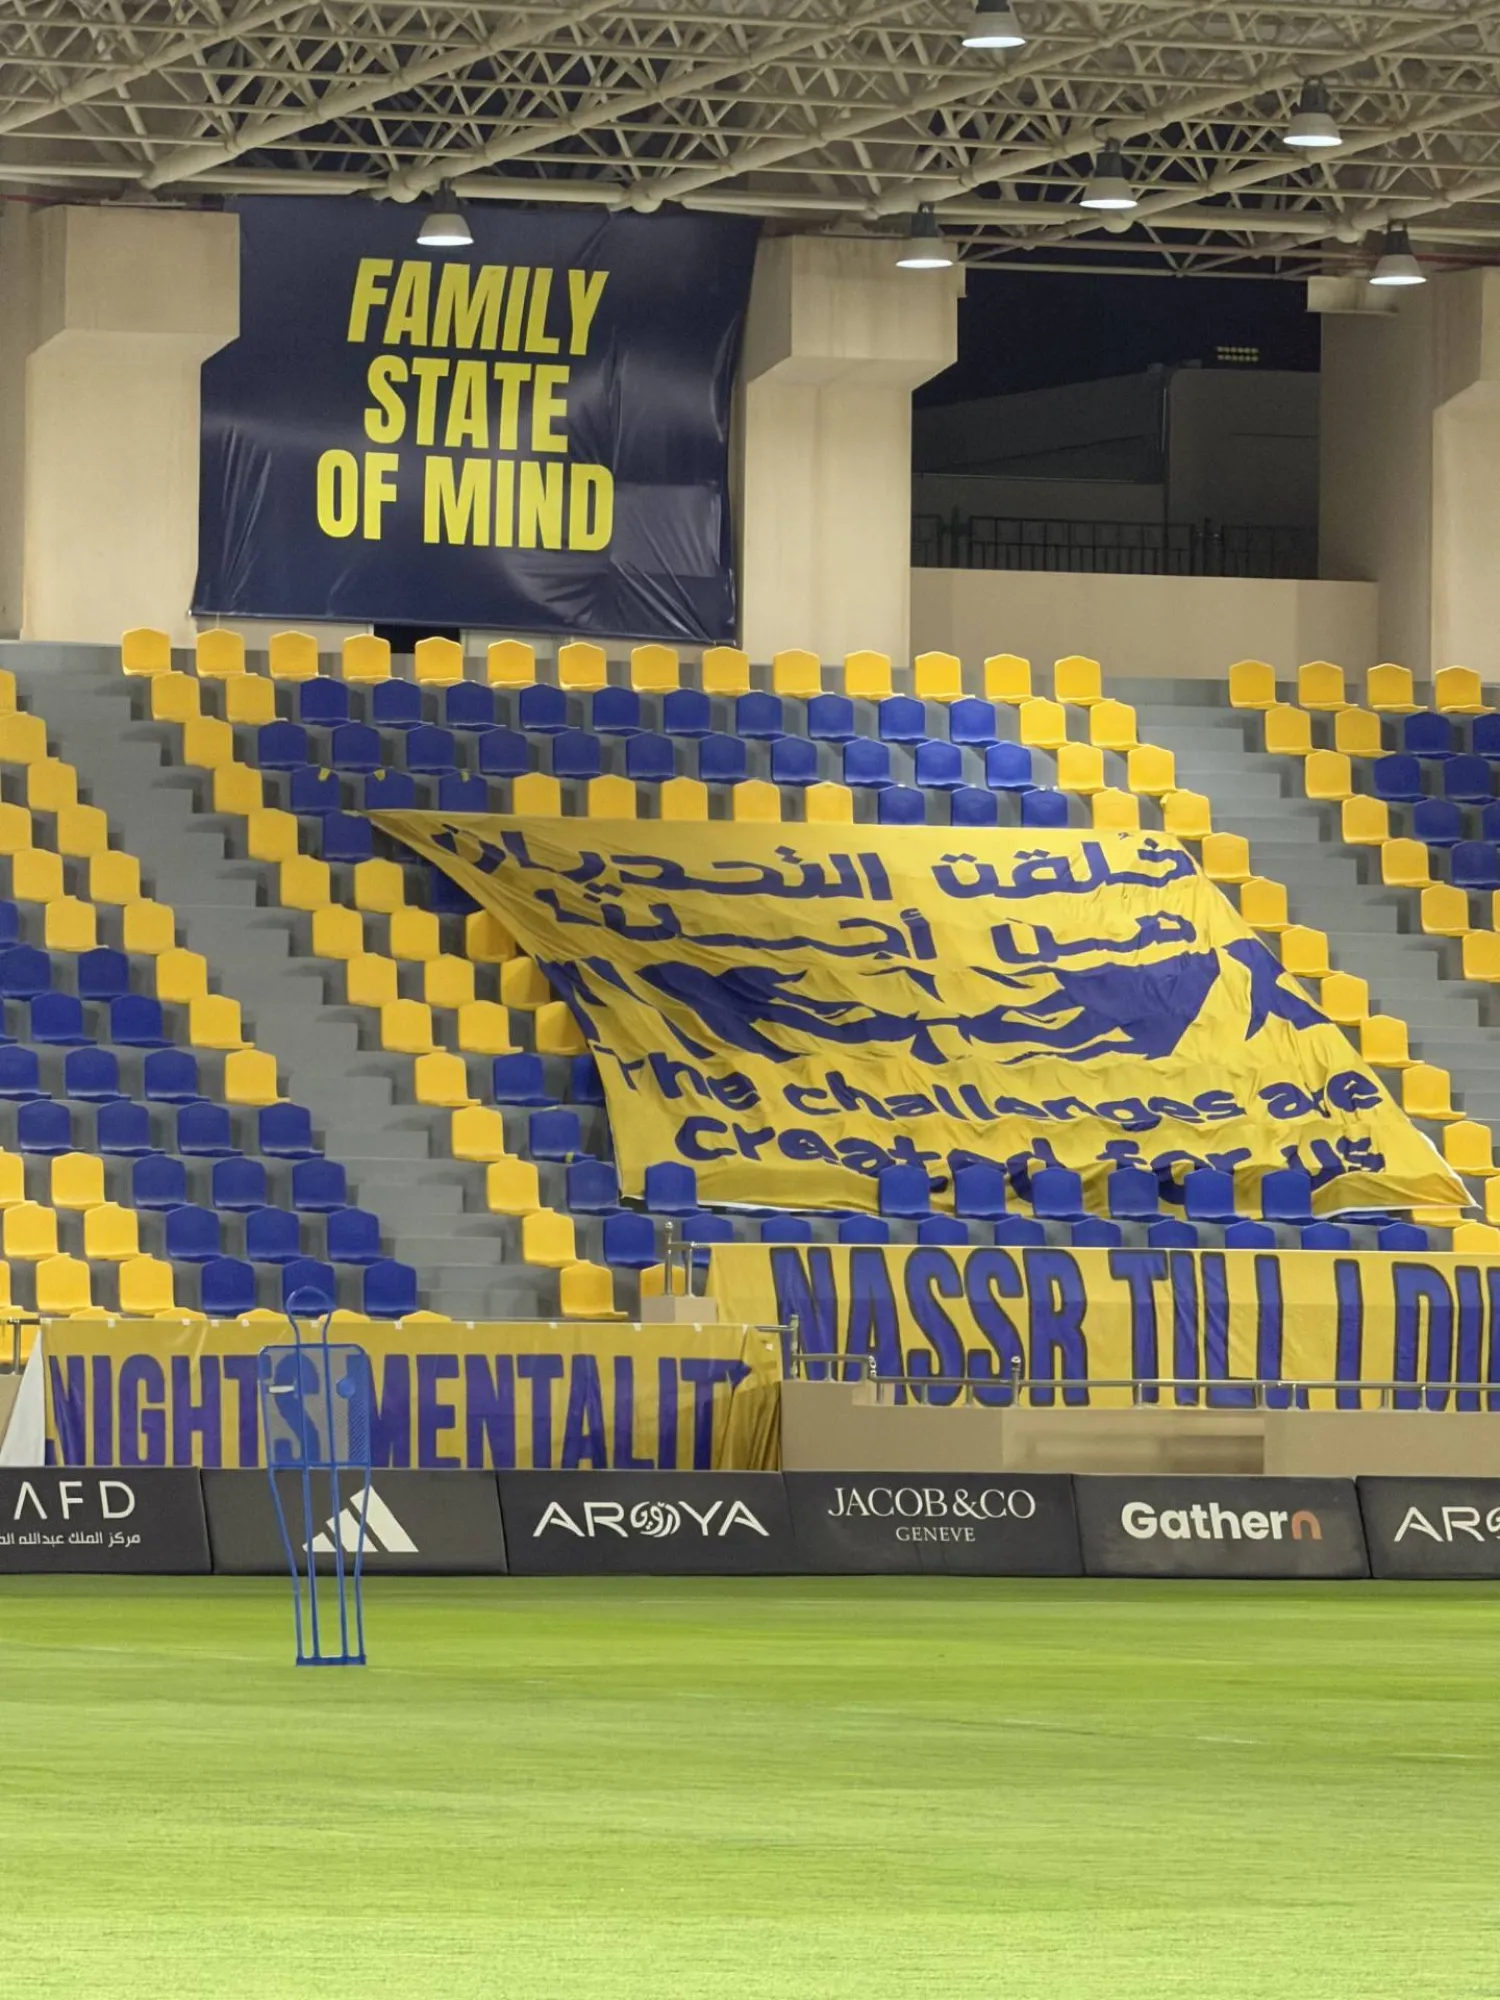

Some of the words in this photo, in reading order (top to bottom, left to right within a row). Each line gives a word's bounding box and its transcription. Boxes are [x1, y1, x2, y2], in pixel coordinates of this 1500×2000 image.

[347, 257, 609, 355] FAMILY
[364, 355, 570, 453] STATE
[316, 449, 397, 541] OF
[424, 456, 614, 552] MIND
[932, 837, 1198, 899] خلقت
[990, 909, 1198, 964] من
[1258, 1070, 1383, 1119] are
[770, 1246, 1090, 1408] NASSR
[1109, 1249, 1309, 1410] TILL
[1334, 1258, 1364, 1410] I
[68, 1530, 103, 1545] الملك
[108, 1531, 141, 1548] مركز
[532, 1500, 770, 1537] AROYA
[896, 1526, 976, 1542] GENEVE
[1121, 1501, 1322, 1540] Gathern
[1394, 1506, 1500, 1542] AR
